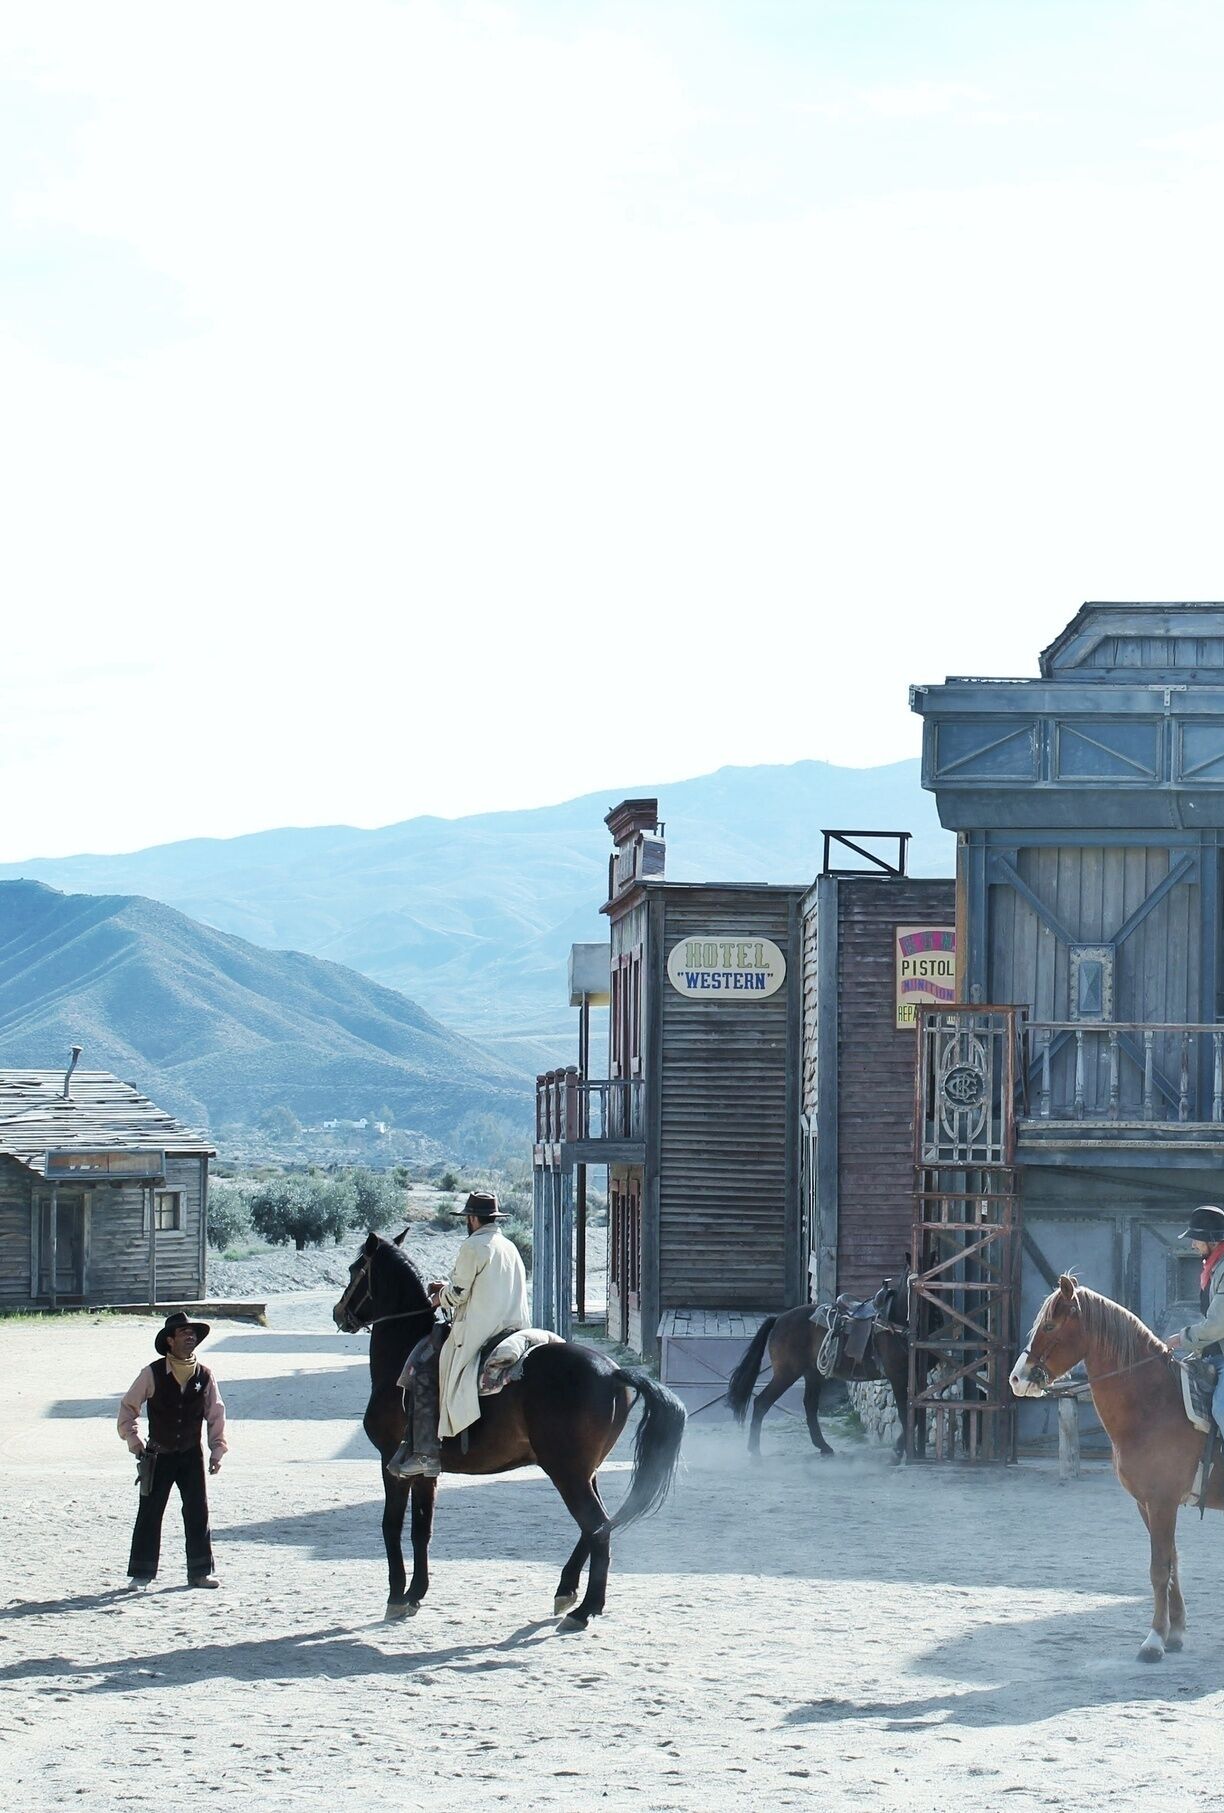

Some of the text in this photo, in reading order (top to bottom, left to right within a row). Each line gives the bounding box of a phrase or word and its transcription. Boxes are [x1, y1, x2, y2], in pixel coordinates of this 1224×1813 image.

[685, 943, 770, 969] HOTEL
[901, 960, 955, 977] PISTOL
[677, 971, 774, 990] "WESTERN"
